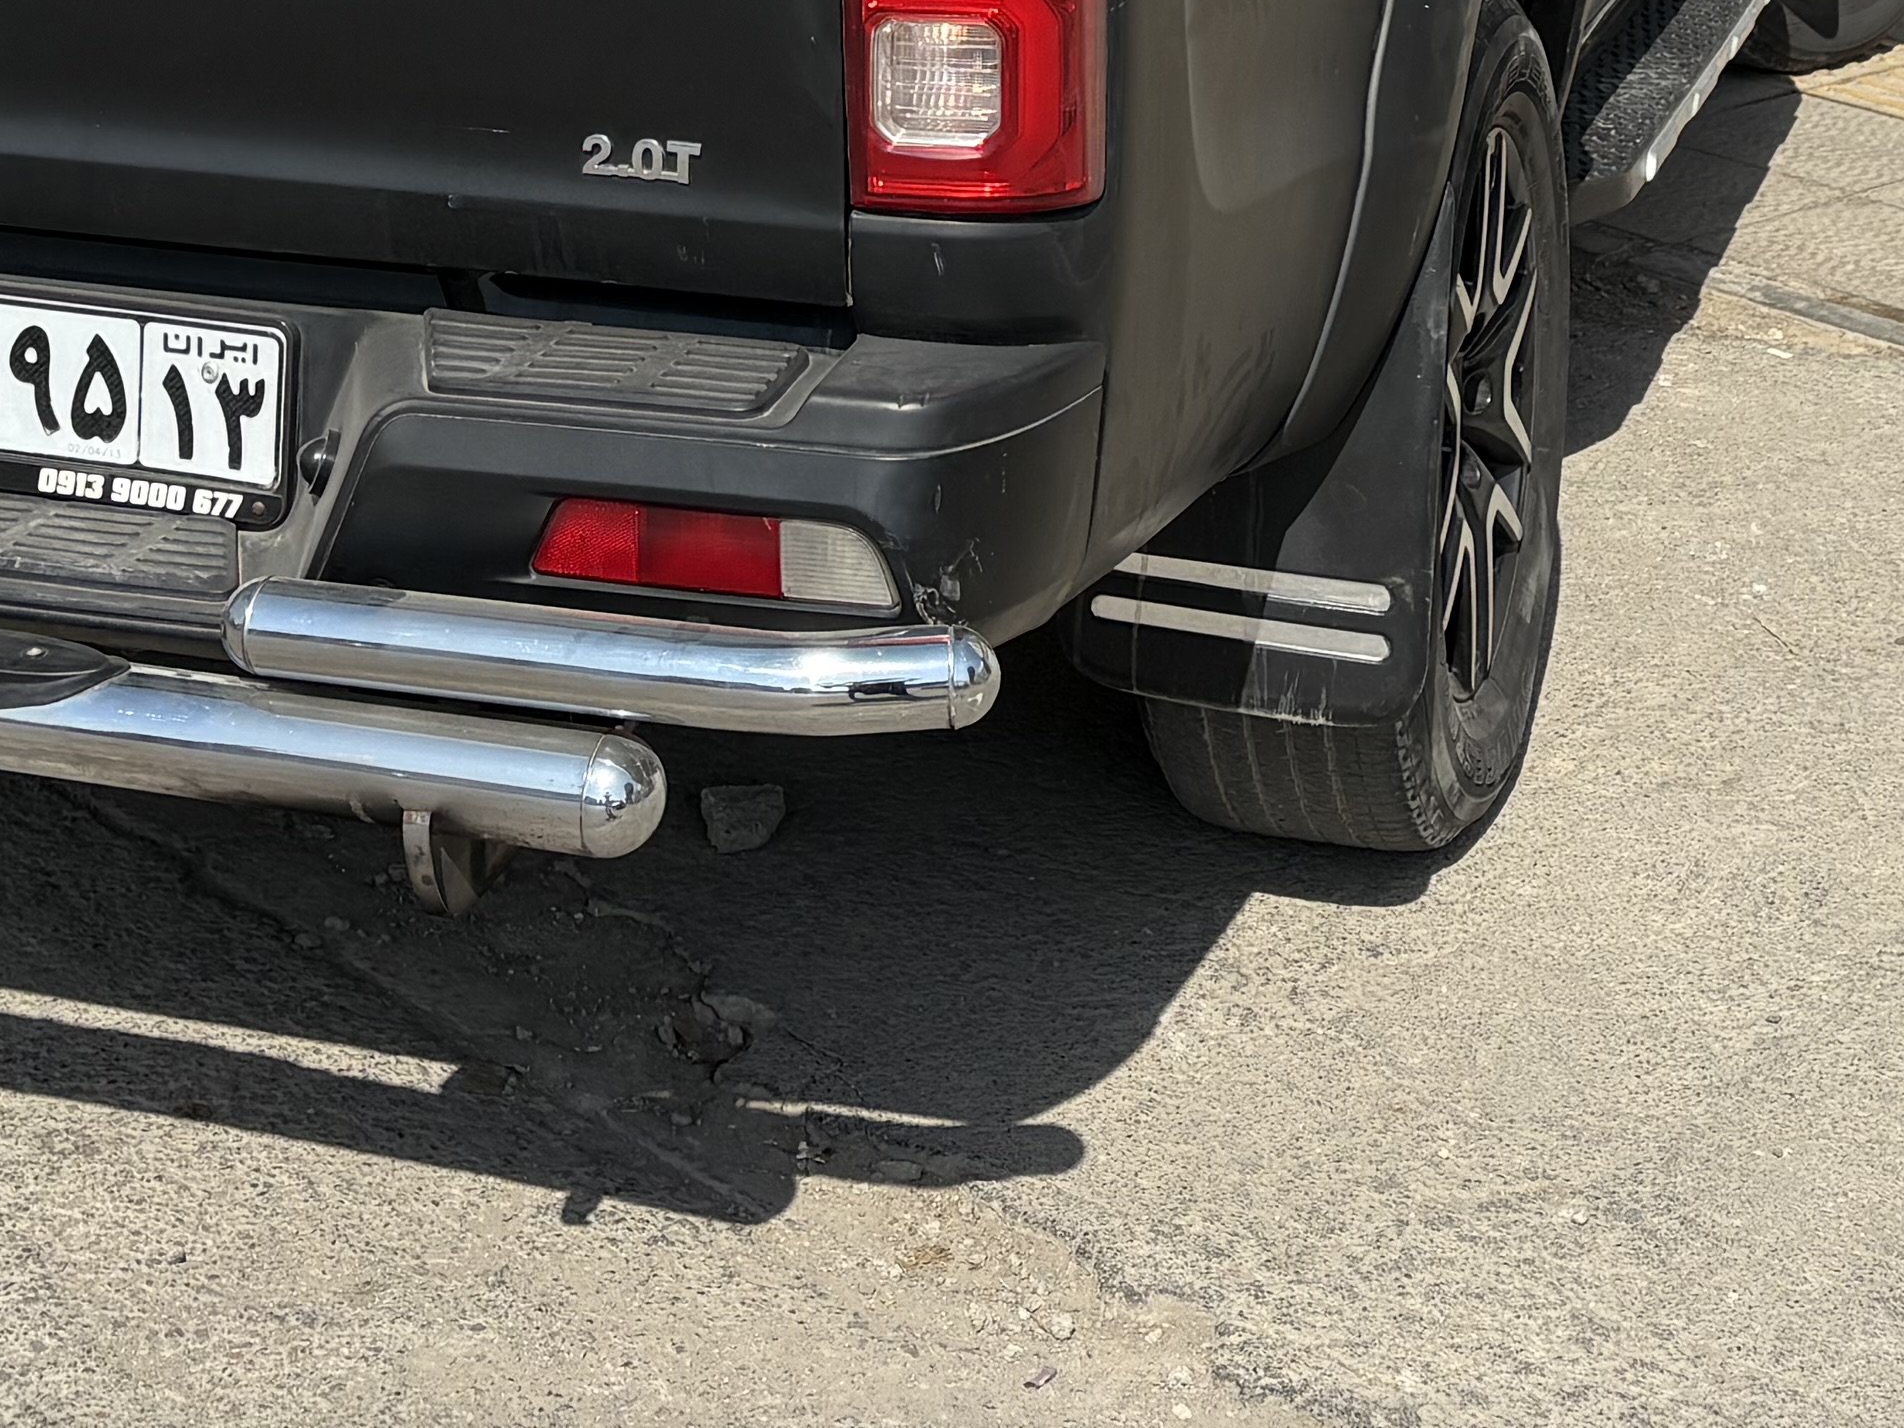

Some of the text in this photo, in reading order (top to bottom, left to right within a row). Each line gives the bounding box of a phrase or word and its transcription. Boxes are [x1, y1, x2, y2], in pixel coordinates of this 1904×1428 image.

[582, 133, 702, 186] 2.0T
[162, 329, 259, 367] ایران
[37, 467, 243, 520] 0913 9000 677
